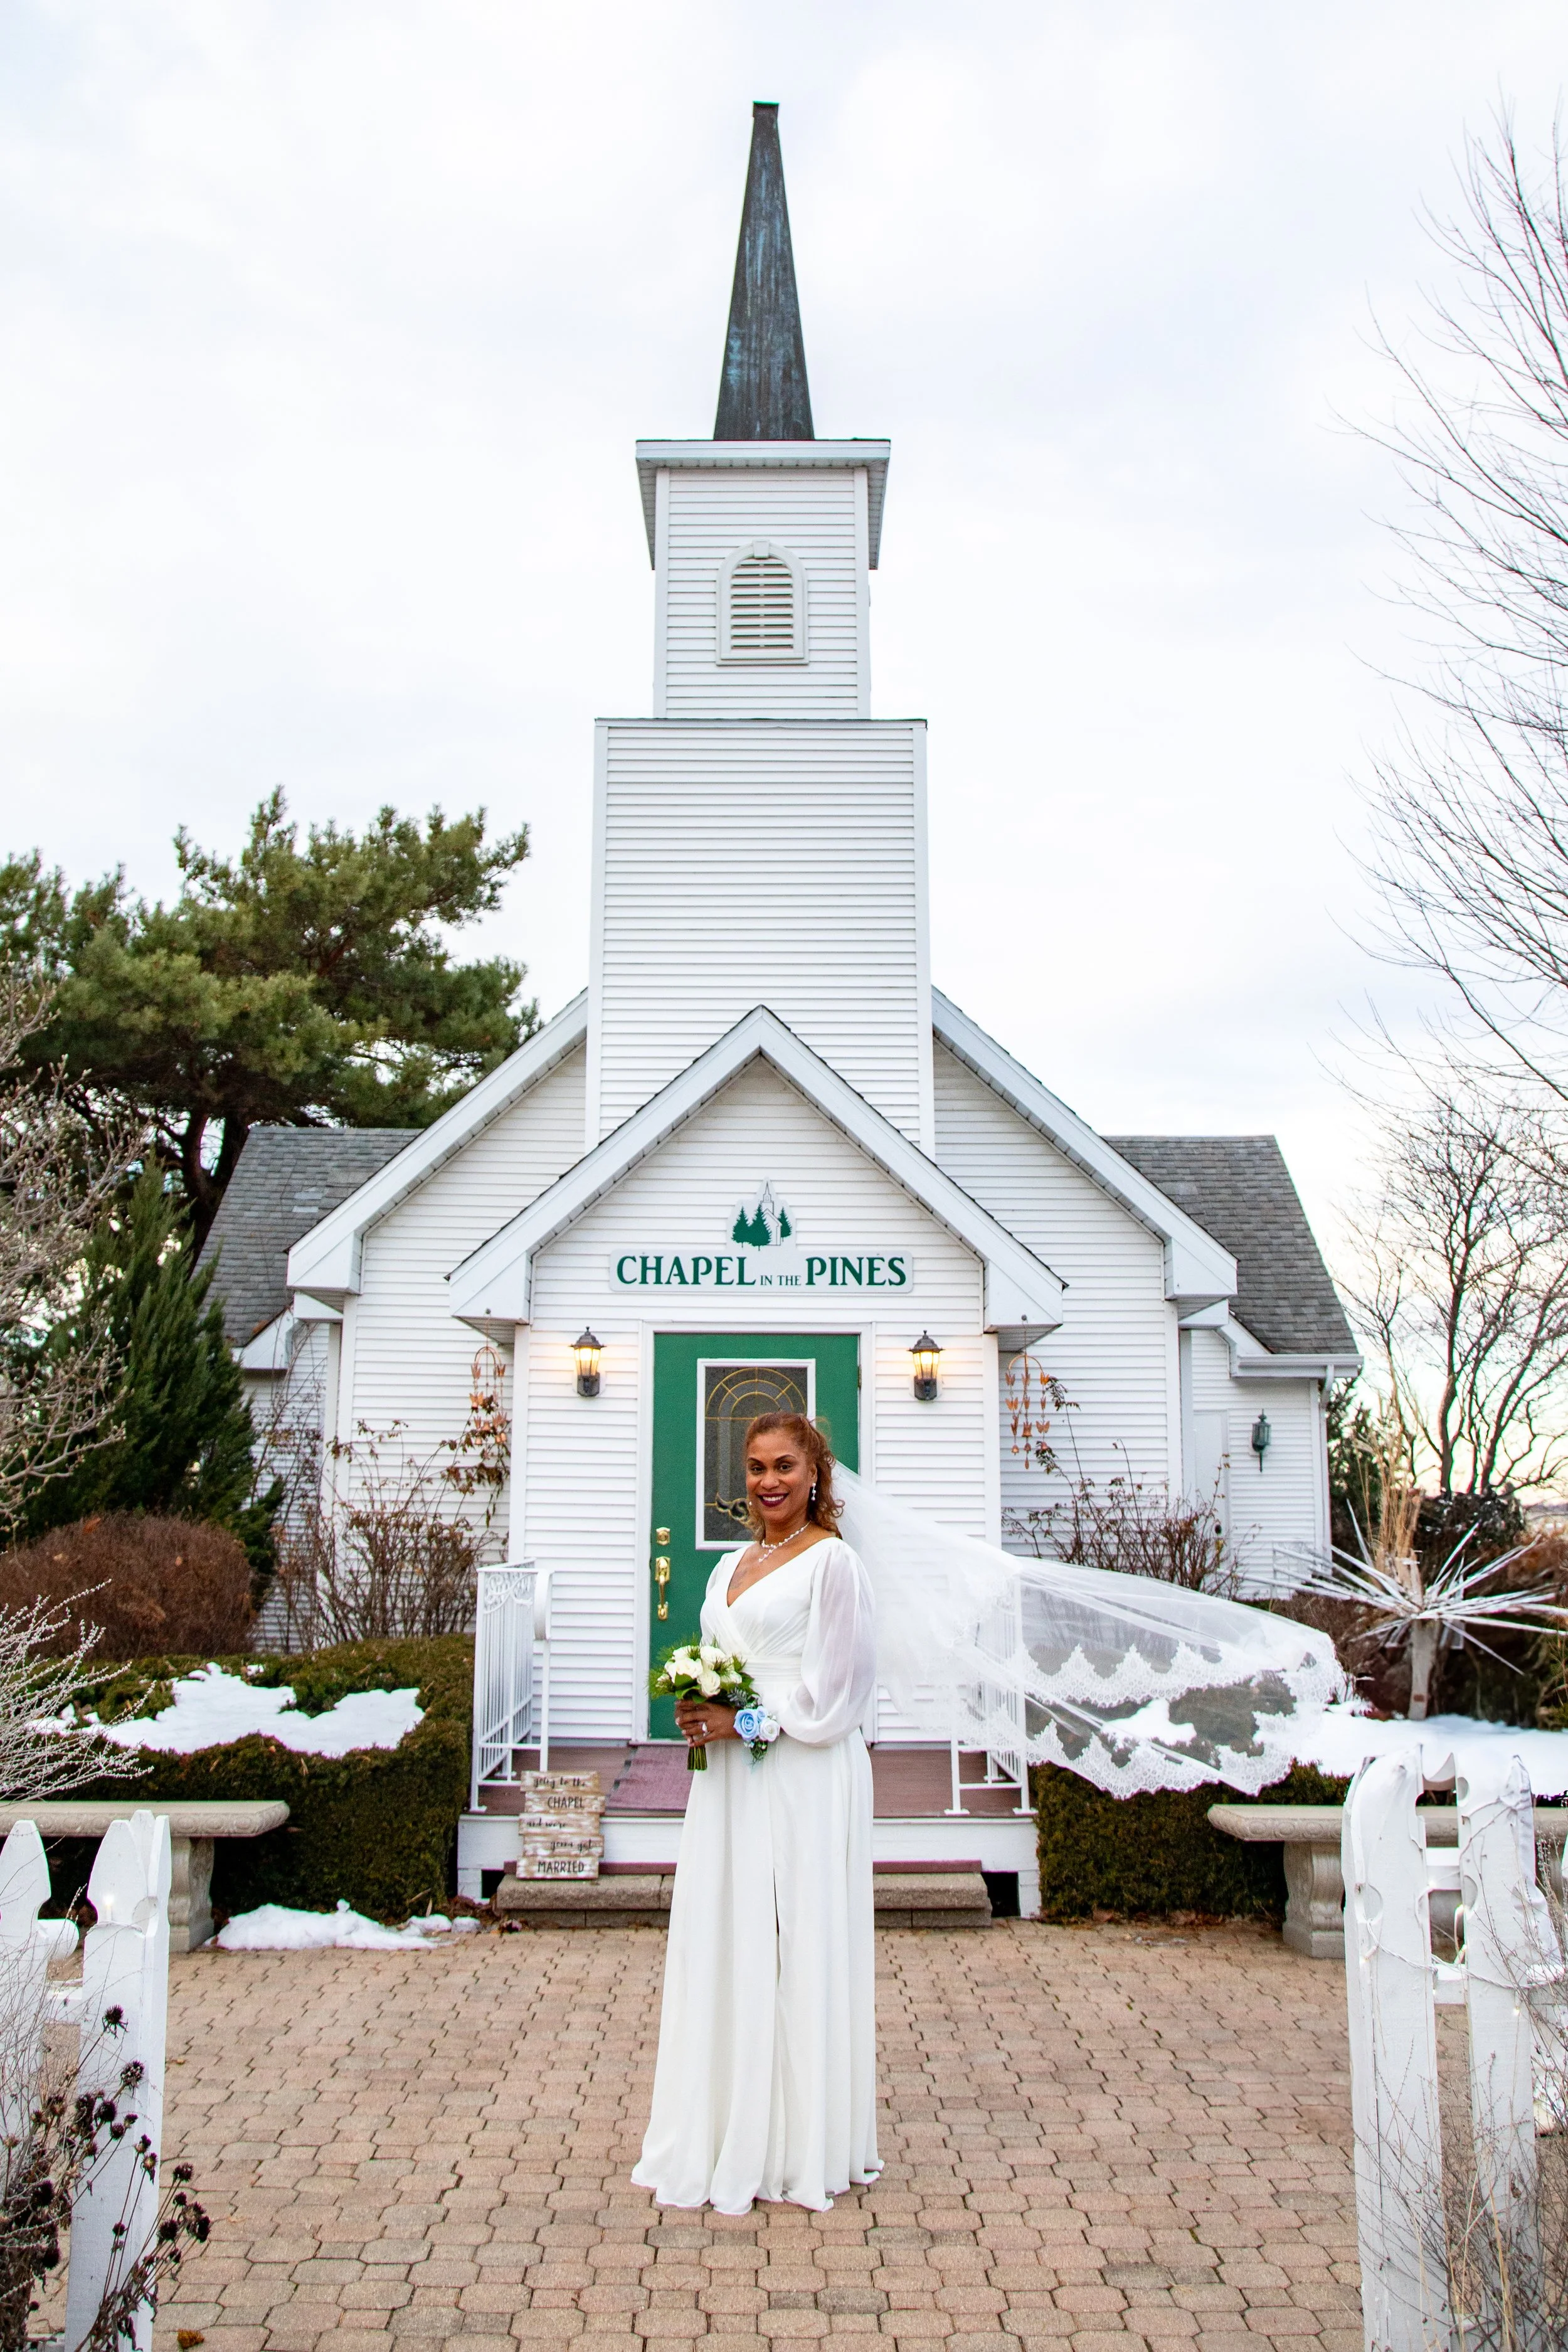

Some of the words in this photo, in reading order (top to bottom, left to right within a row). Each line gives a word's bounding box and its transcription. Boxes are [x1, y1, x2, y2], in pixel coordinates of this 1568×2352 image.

[617, 1256, 756, 1285] CHAPEL
[760, 1274, 773, 1286] IN
[776, 1274, 802, 1286] THE
[805, 1256, 907, 1286] PINES
[548, 1796, 583, 1808] CHAPEL
[538, 1861, 585, 1873] MARRIED
